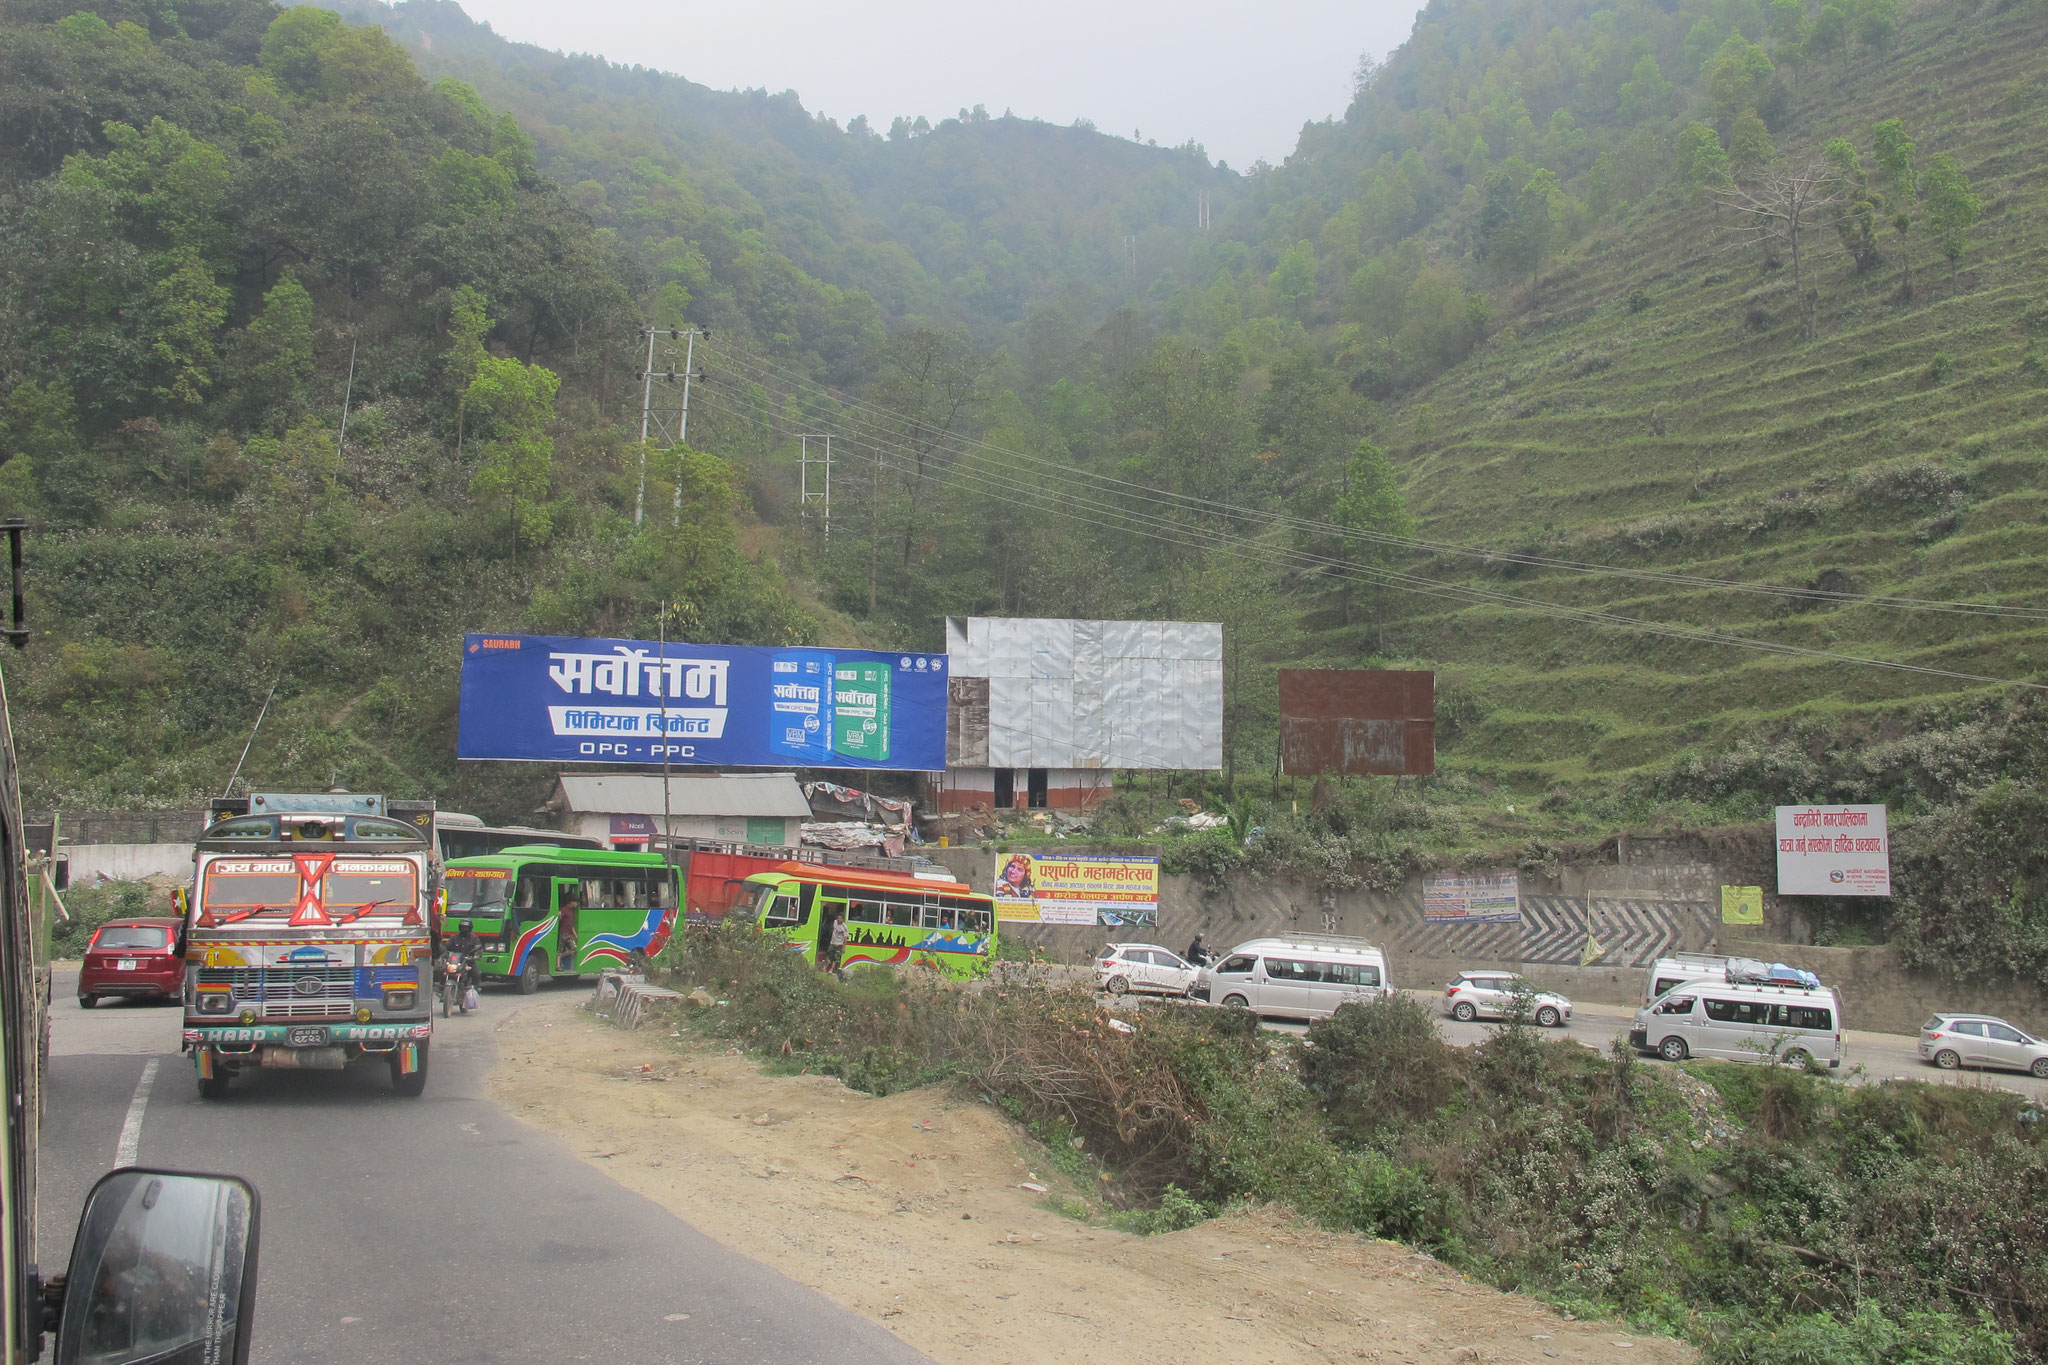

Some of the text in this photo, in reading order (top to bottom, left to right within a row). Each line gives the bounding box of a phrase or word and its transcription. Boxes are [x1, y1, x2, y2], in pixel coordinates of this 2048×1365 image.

[483, 639, 521, 649] SAURABH
[565, 710, 640, 730] प्रिमियम
[580, 742, 628, 755] OPC
[650, 745, 695, 758] PPC
[1823, 808, 1868, 828] नगरपालिकामा
[1780, 838, 1794, 852] यात्रा
[1808, 835, 1832, 852] भएकोमा
[1834, 834, 1854, 854] हार्दिक
[1856, 838, 1880, 853] धन्यवाद
[220, 863, 291, 873] जय माता
[337, 864, 406, 872] मनकामना
[474, 870, 506, 878] यातायात
[1040, 863, 1154, 881] पशुपति महामहोत्सव
[208, 1030, 266, 1042] HARD
[349, 1028, 410, 1039] WORK
[216, 1293, 226, 1322] APPEAR
[206, 1308, 215, 1338] MIRROR
[204, 1340, 212, 1355] THE
[204, 1356, 210, 1364] IN
